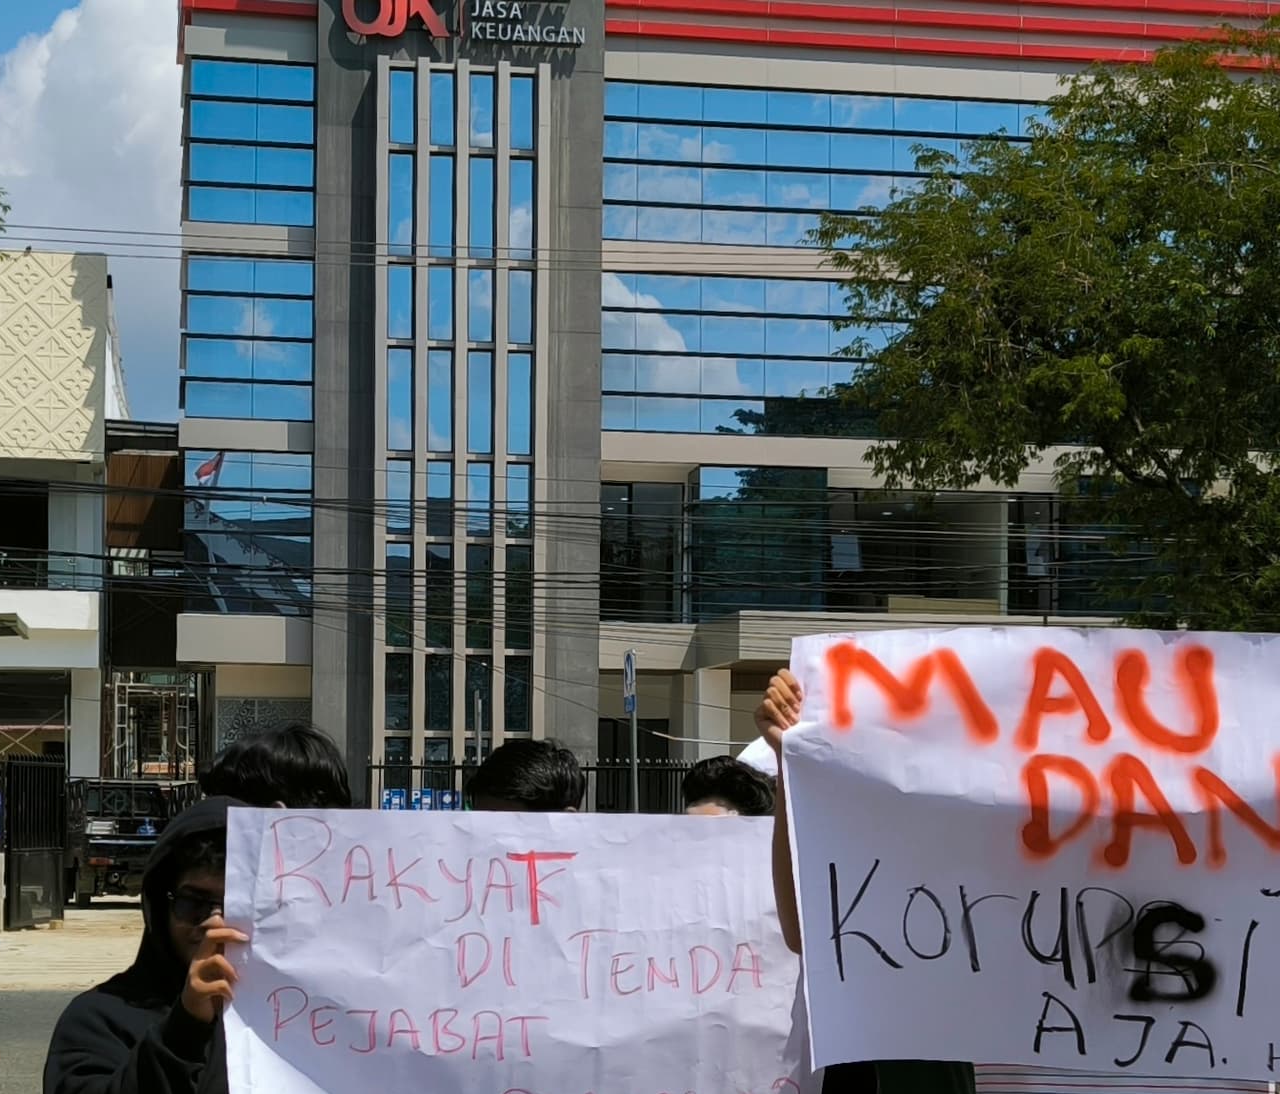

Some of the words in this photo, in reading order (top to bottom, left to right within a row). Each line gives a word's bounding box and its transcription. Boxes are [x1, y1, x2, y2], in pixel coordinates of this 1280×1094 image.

[471, 0, 522, 19] JASA
[471, 22, 586, 44] KEUANGAN
[824, 643, 1223, 755] MAU
[455, 932, 518, 988] DI
[567, 929, 764, 999] TENDA
[266, 986, 549, 1062] PEJABAT
